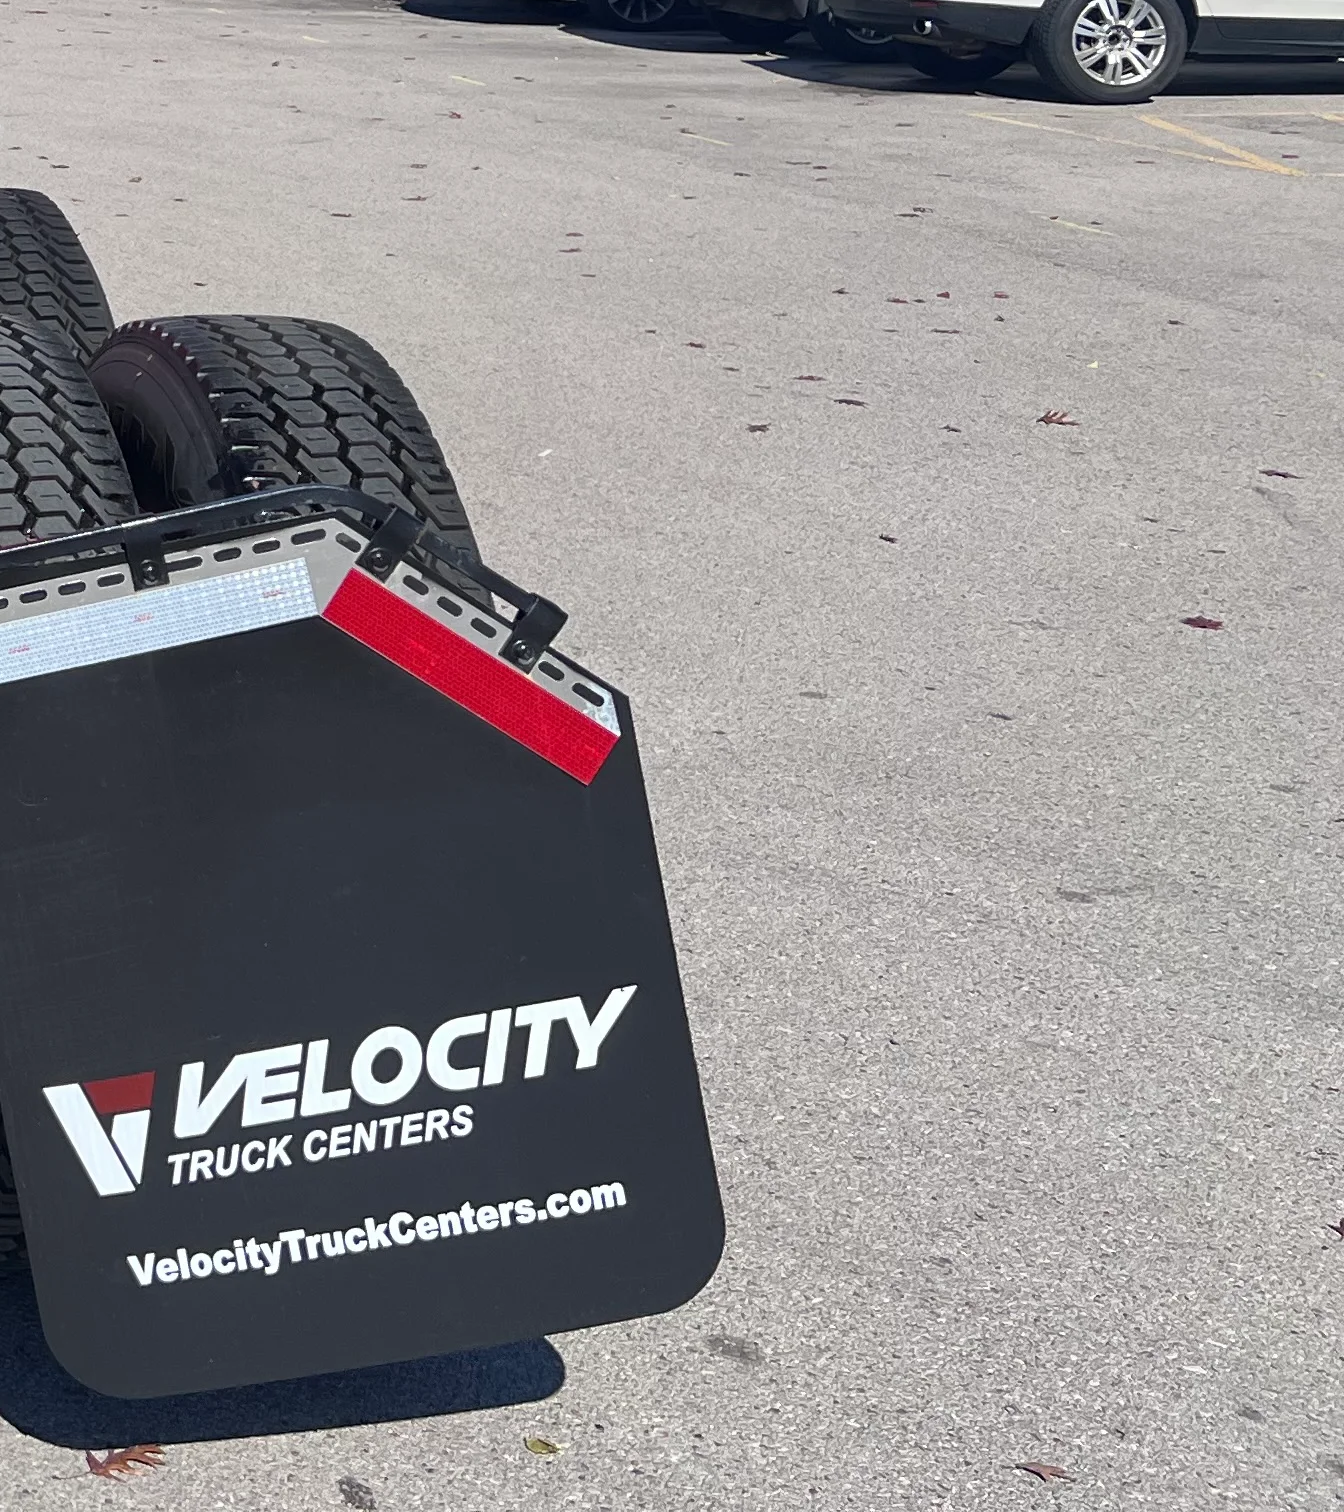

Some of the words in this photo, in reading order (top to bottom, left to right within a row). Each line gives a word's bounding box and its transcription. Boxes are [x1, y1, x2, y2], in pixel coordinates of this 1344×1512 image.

[174, 985, 638, 1139] VELOCITY
[168, 1135, 293, 1186] TRUCK
[303, 1104, 474, 1162] CENTERS
[127, 1182, 627, 1287] VelocityTruckCenters.com
